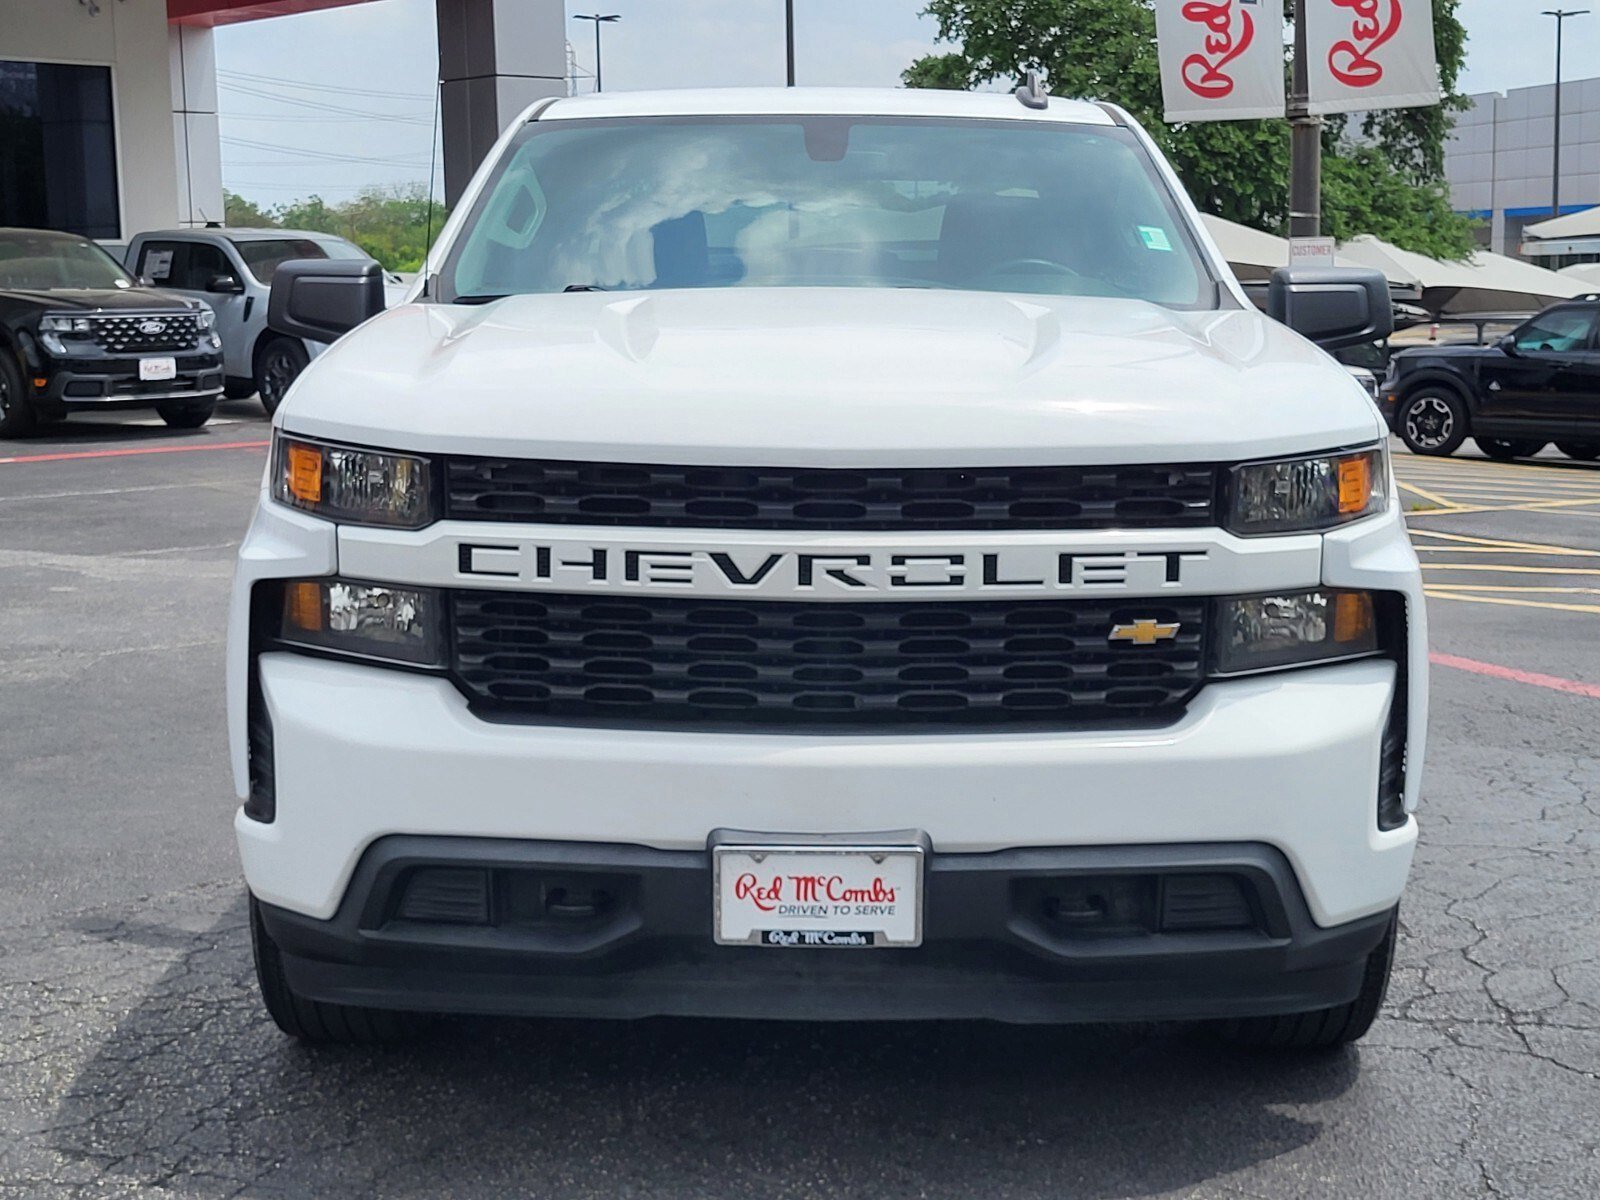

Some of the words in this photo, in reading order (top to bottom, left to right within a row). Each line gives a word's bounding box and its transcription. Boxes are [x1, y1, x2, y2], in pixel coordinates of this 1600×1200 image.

[1182, 0, 1254, 98] Red
[458, 542, 1208, 588] CHEVROLET
[735, 873, 782, 911] Red
[788, 875, 896, 903] McCombs
[778, 905, 827, 915] DRIVEN
[832, 905, 850, 915] TO
[854, 905, 896, 915] SERVE
